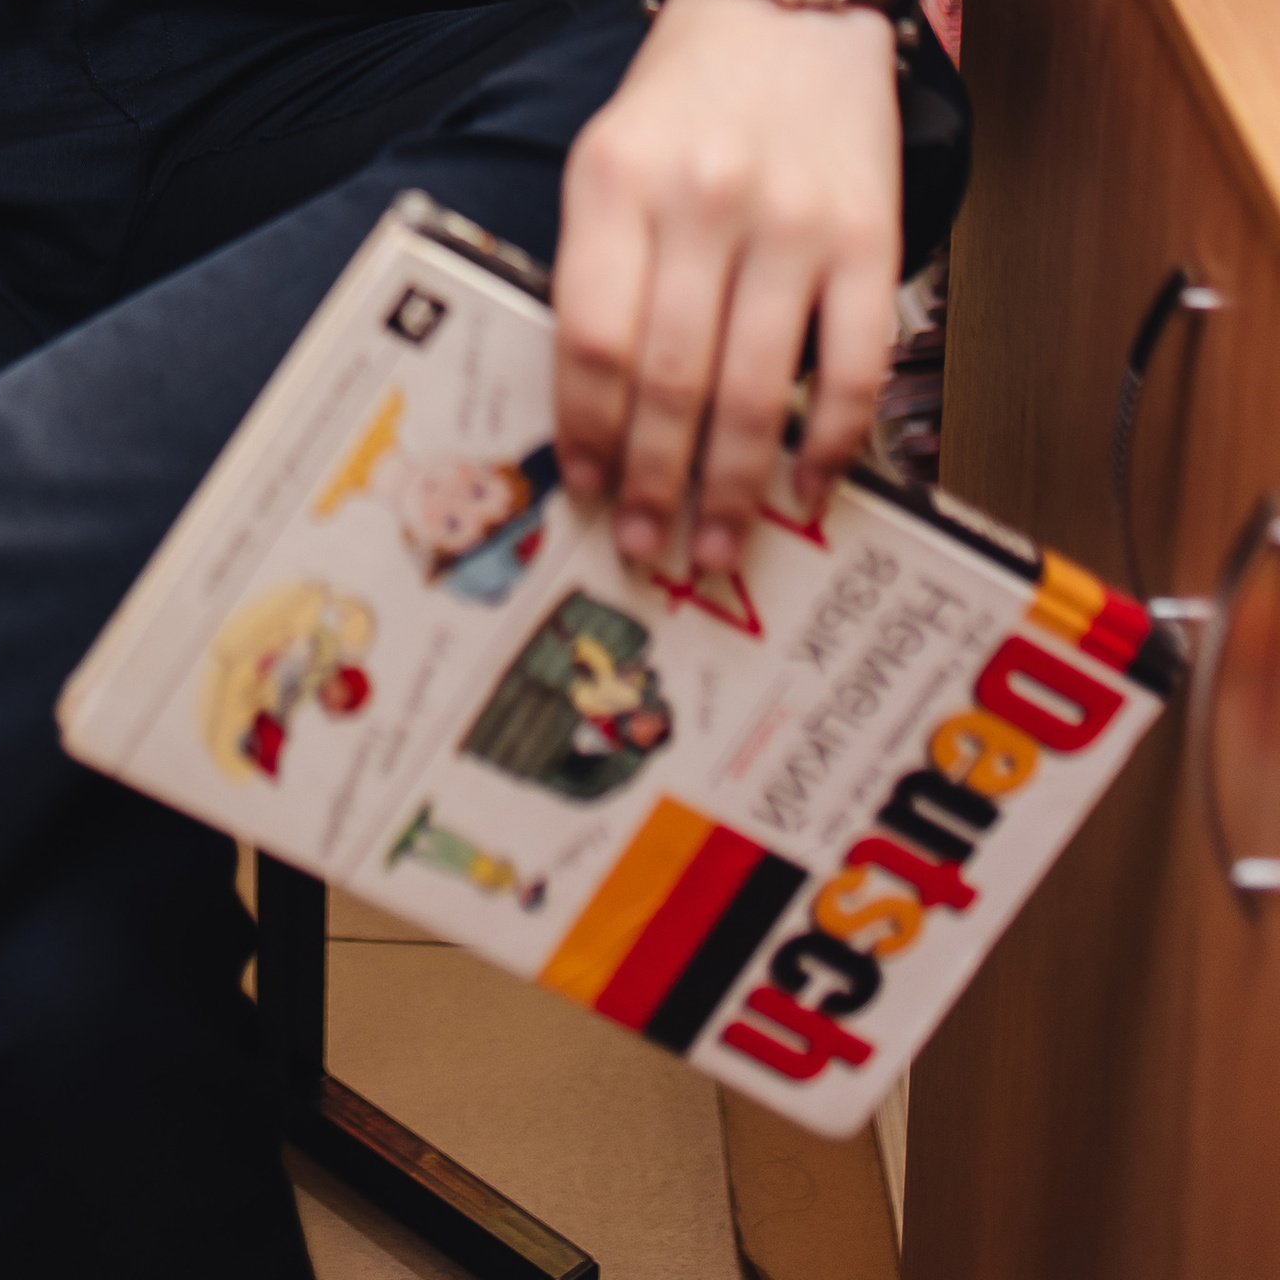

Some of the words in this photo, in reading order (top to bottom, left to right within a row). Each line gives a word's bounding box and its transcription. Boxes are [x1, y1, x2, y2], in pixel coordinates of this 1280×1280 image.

[752, 577, 969, 833] Немецкий
[789, 547, 902, 673] язык
[720, 634, 1126, 1080] Deutsch
